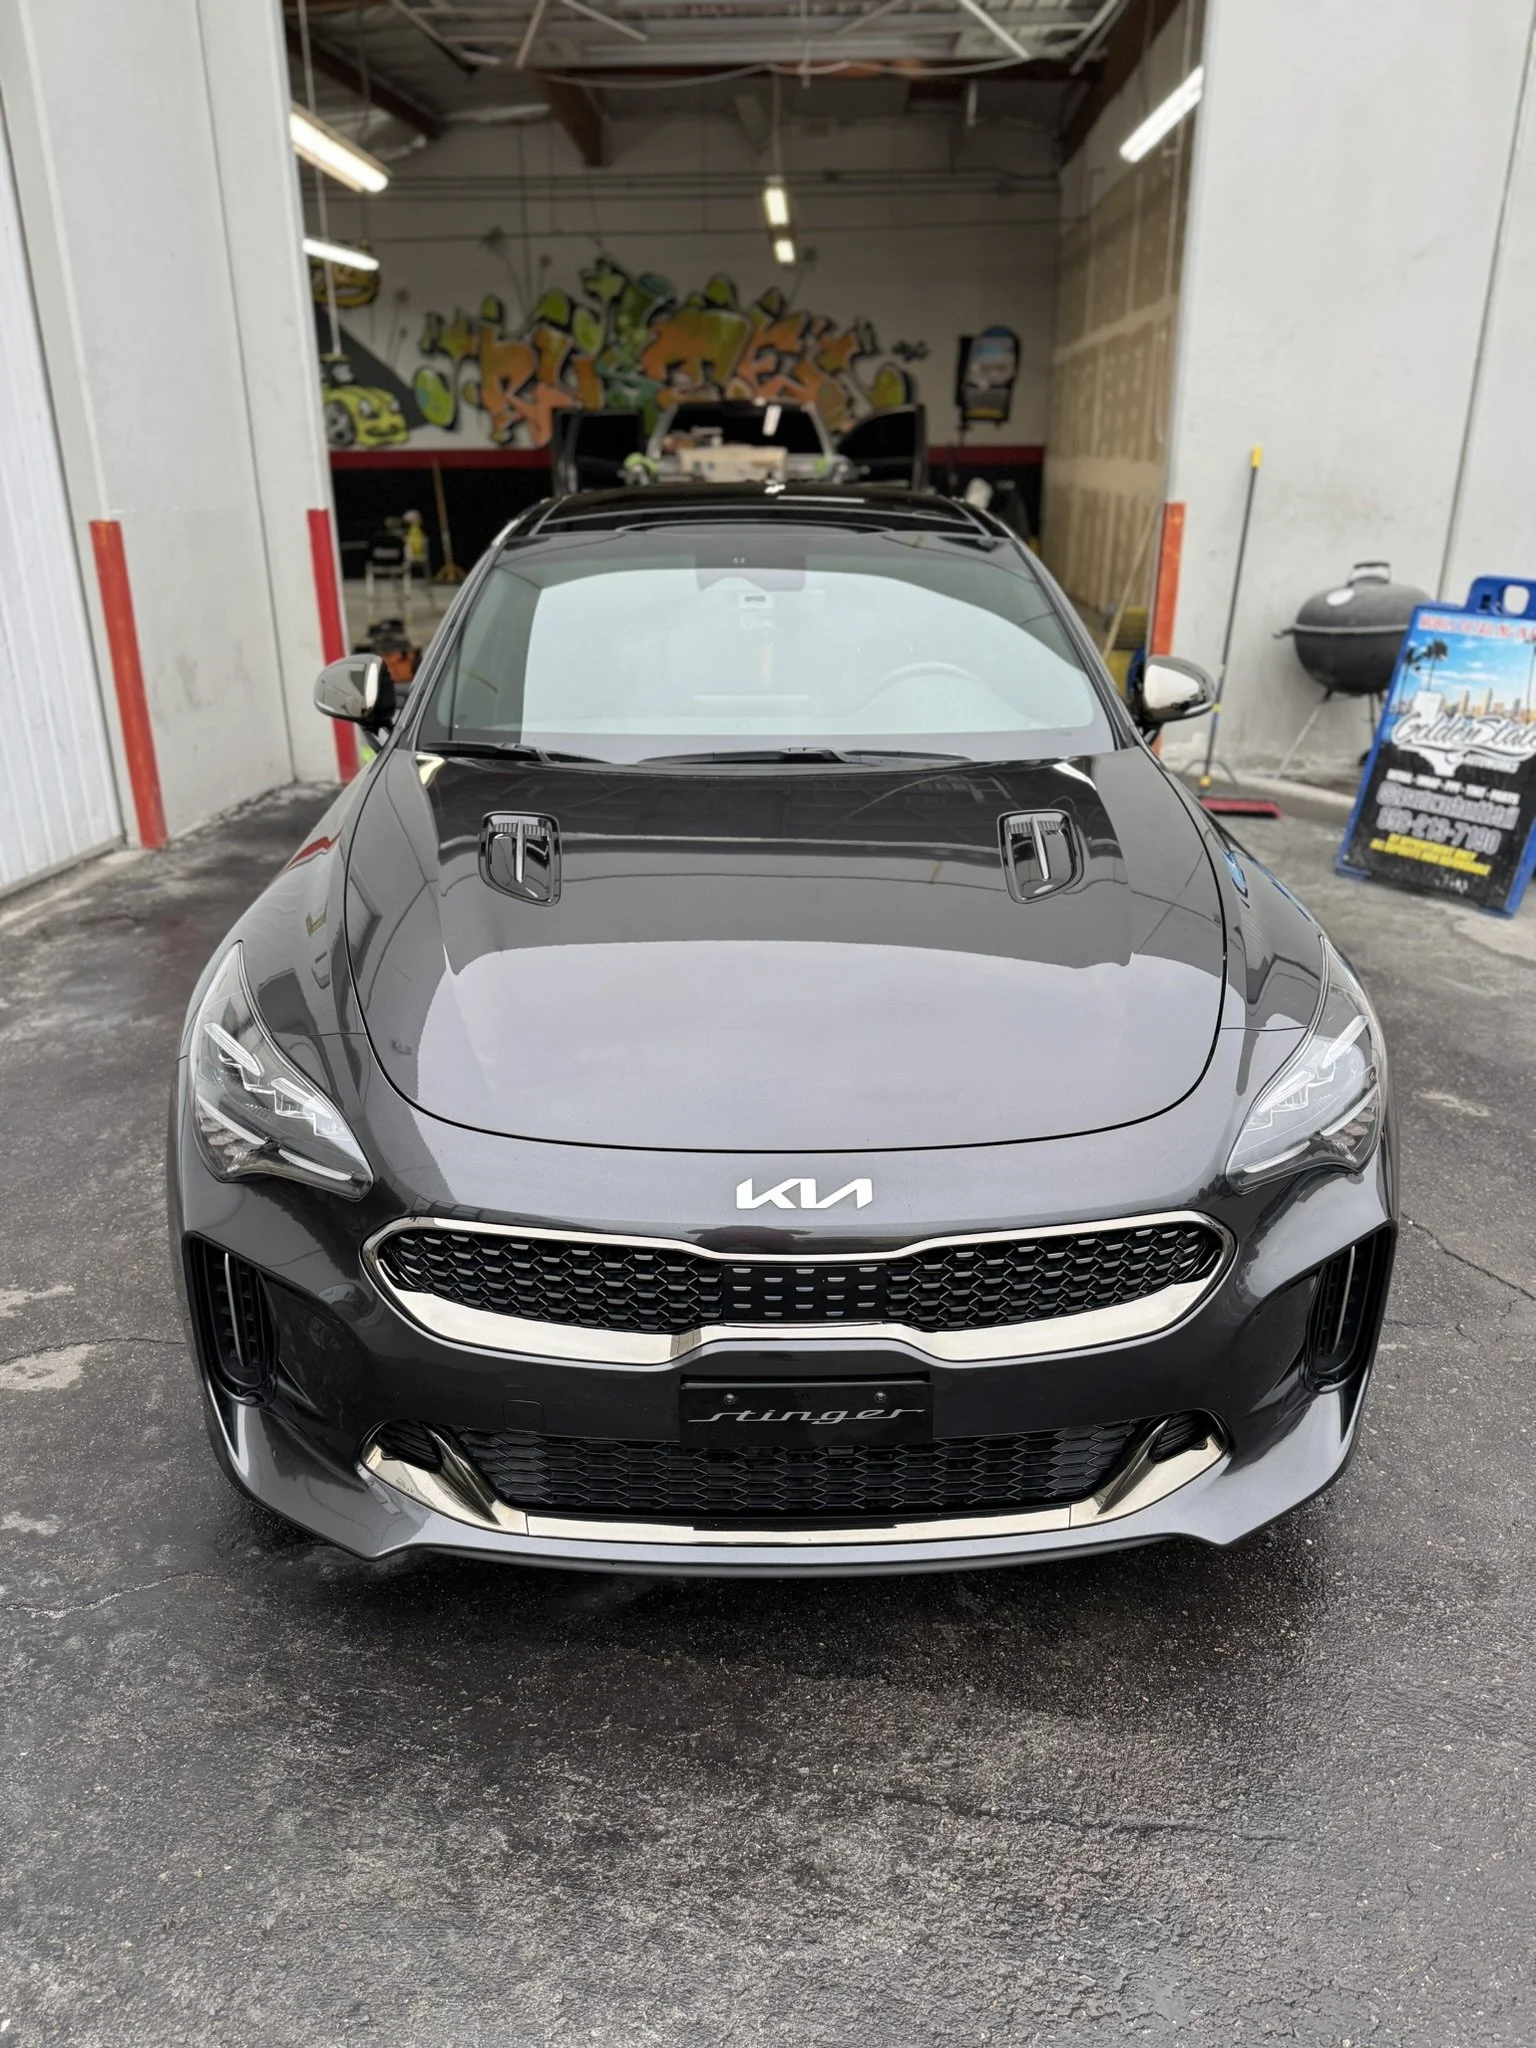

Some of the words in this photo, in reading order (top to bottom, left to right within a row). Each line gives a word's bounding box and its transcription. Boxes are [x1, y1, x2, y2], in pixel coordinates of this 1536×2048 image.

[1393, 709, 1484, 746] Golden
[736, 1178, 873, 1209] KIA
[688, 1409, 925, 1424] stinger
